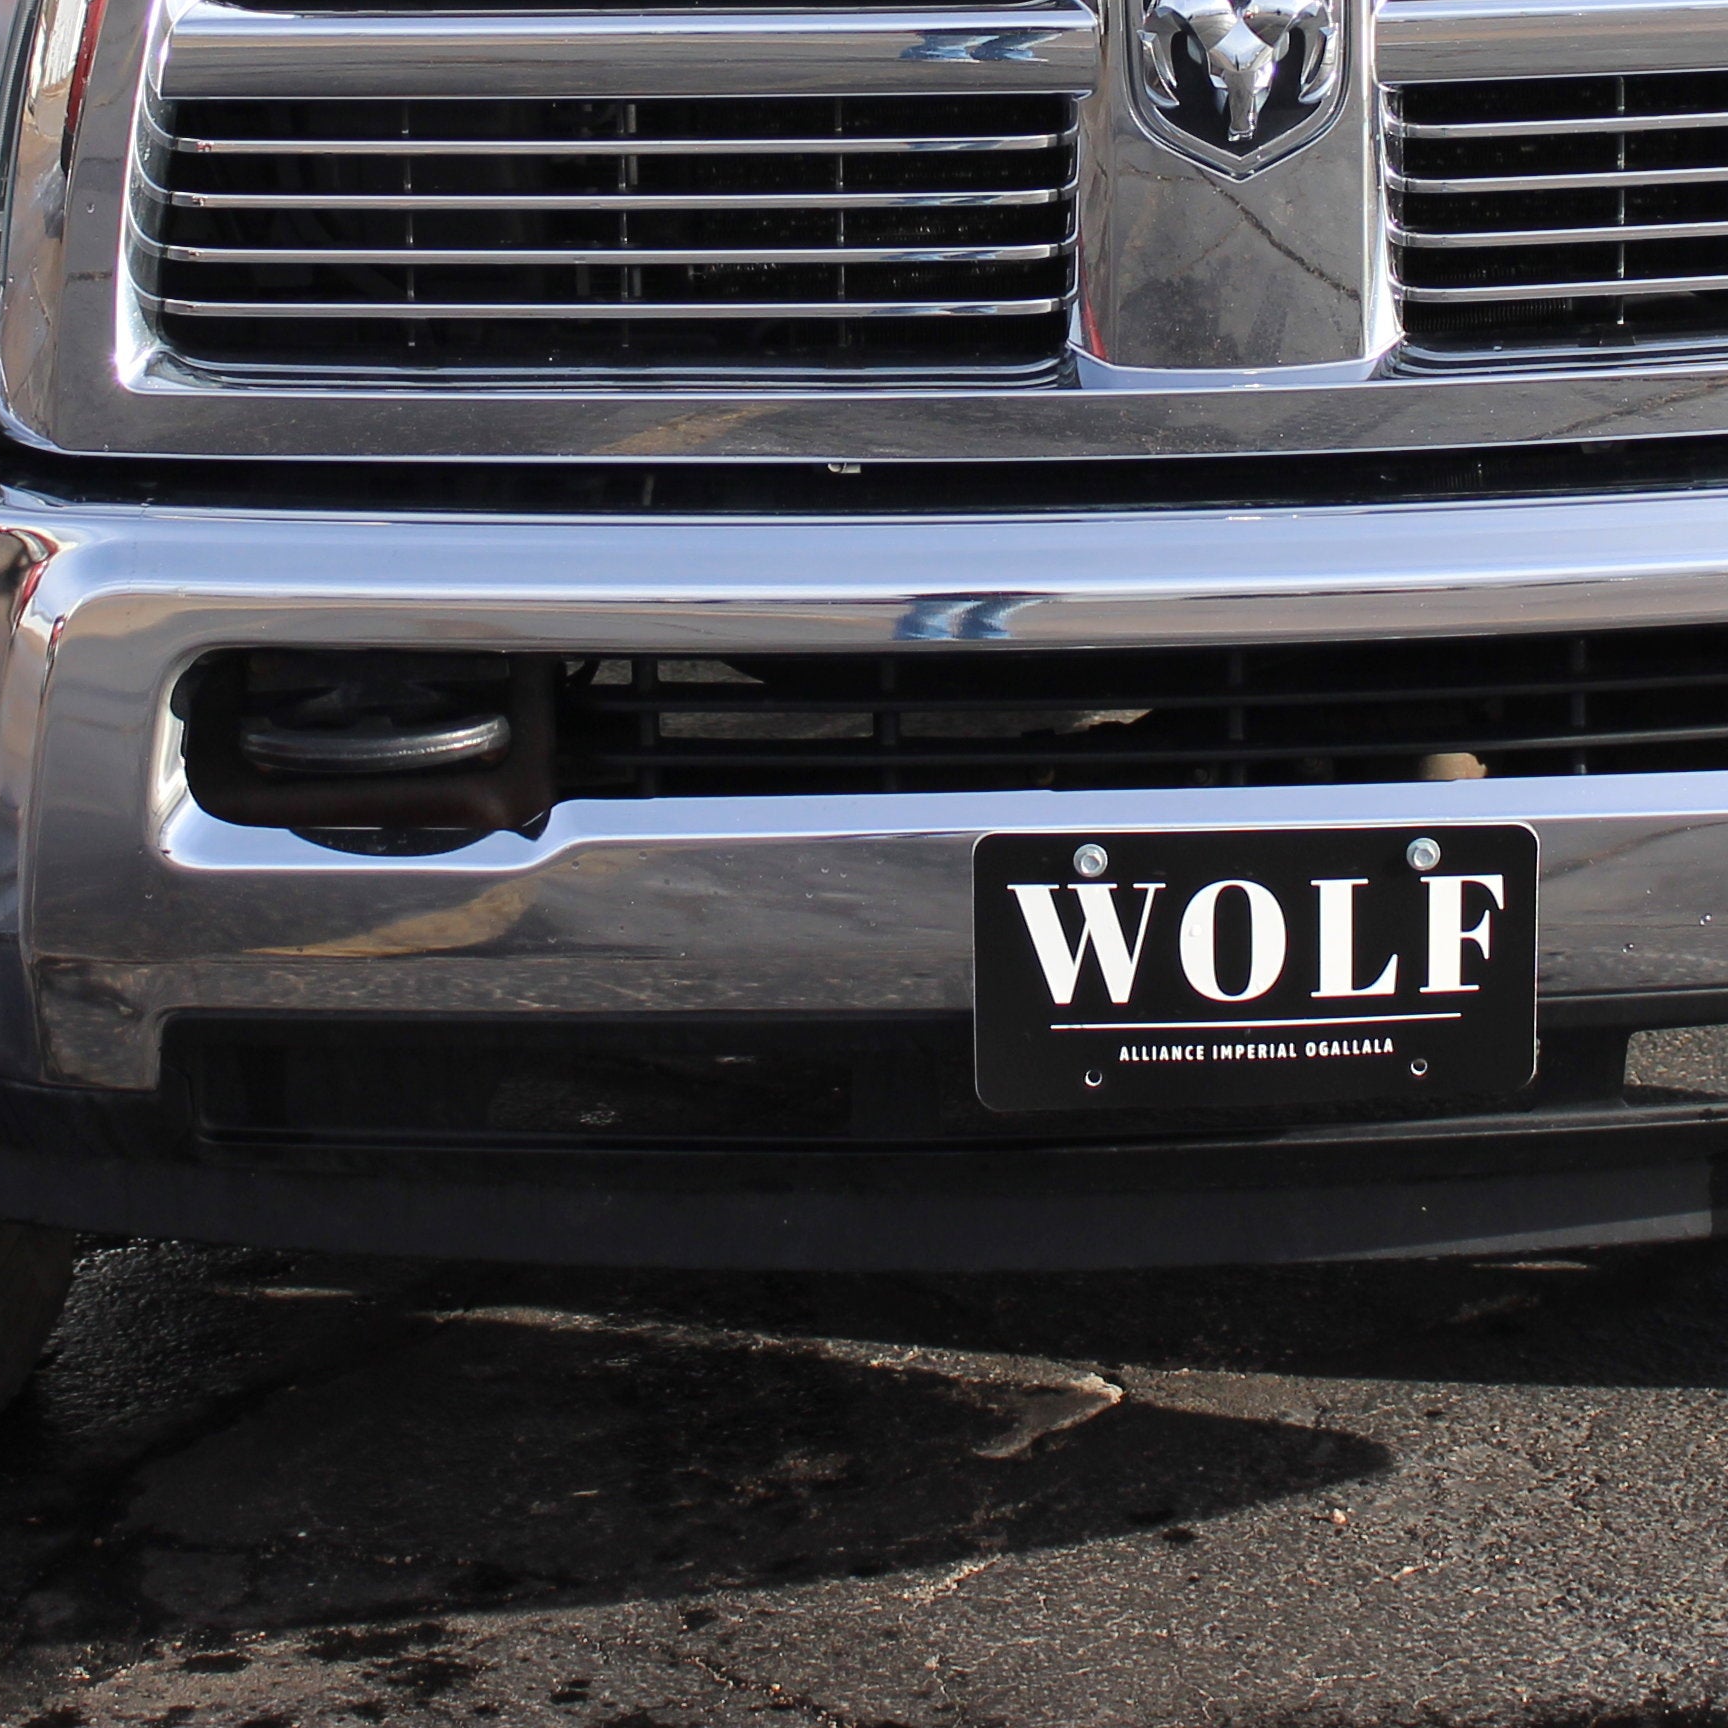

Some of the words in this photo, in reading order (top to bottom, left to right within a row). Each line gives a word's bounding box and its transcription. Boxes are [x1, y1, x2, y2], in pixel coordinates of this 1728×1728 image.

[1006, 874, 1505, 1005] WOLF
[1119, 1045, 1205, 1062] ALLIANCE
[1212, 1043, 1297, 1060] IMPERIAL
[1305, 1037, 1394, 1058] OGALLALA
